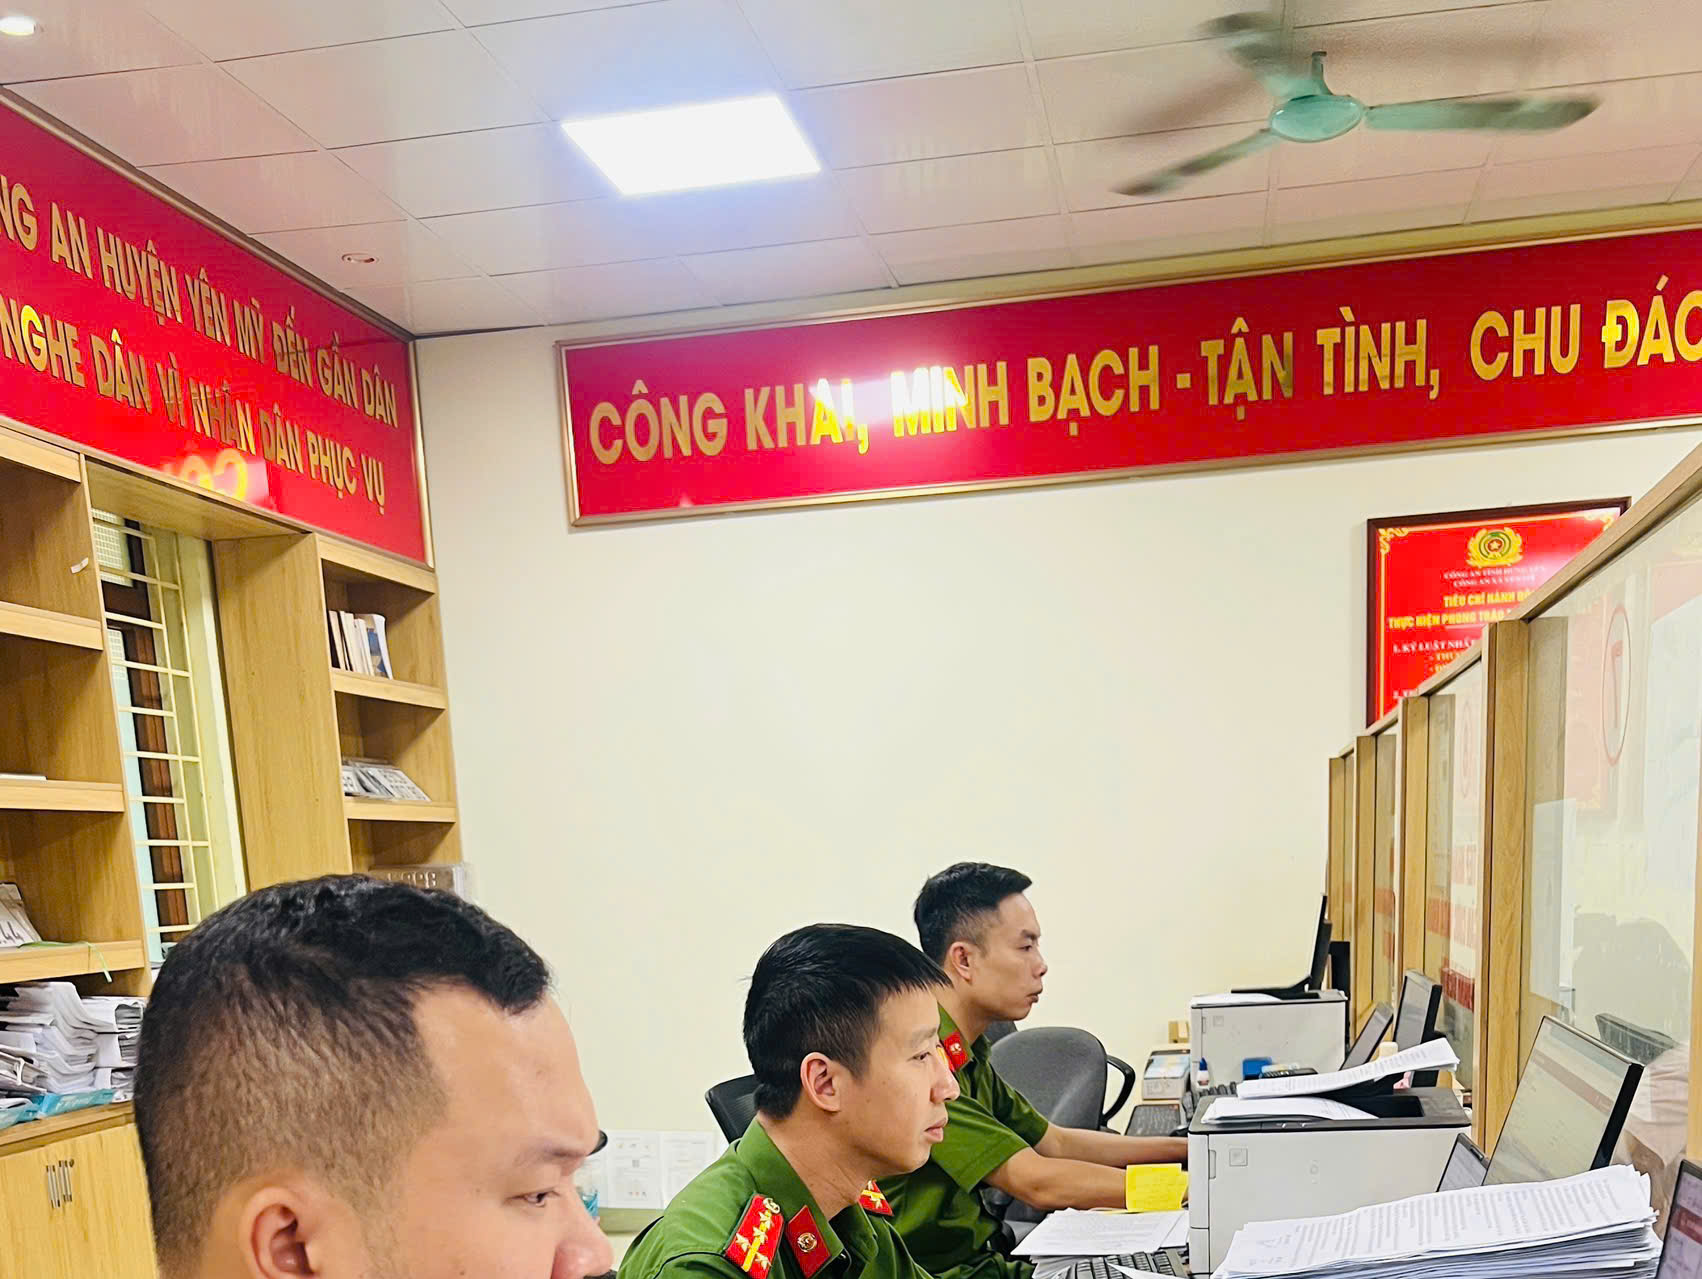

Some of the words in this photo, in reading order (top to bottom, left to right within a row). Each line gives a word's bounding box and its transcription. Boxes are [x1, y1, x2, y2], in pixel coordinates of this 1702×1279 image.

[51, 202, 93, 279] AN
[96, 227, 183, 325] HUYỆN
[184, 266, 231, 347] YÊN
[272, 305, 313, 388] ĐẾN
[316, 331, 358, 409] GẦN
[360, 364, 398, 428] DÂN
[589, 379, 728, 465] CÔNG
[744, 377, 870, 455] KHAI,
[889, 360, 1010, 438] MINH
[1027, 344, 1160, 436] BẠCH
[1200, 316, 1294, 420] TẬN
[1316, 306, 1440, 400] TÌNH,
[1469, 303, 1582, 381] CHU
[90, 328, 152, 414] DÂN
[156, 352, 186, 427] VÌ
[188, 377, 256, 456] NHÂN
[258, 402, 304, 474] DÂN
[306, 430, 357, 501] PHỤC
[361, 455, 386, 515] VỤ
[1388, 616, 1415, 631] THỰC
[1416, 612, 1440, 628] HIỆN
[1441, 611, 1477, 625] PHONG
[1479, 608, 1505, 622] TRÀO
[1467, 591, 1486, 605] CHÍ
[1487, 589, 1516, 604] HÀNH
